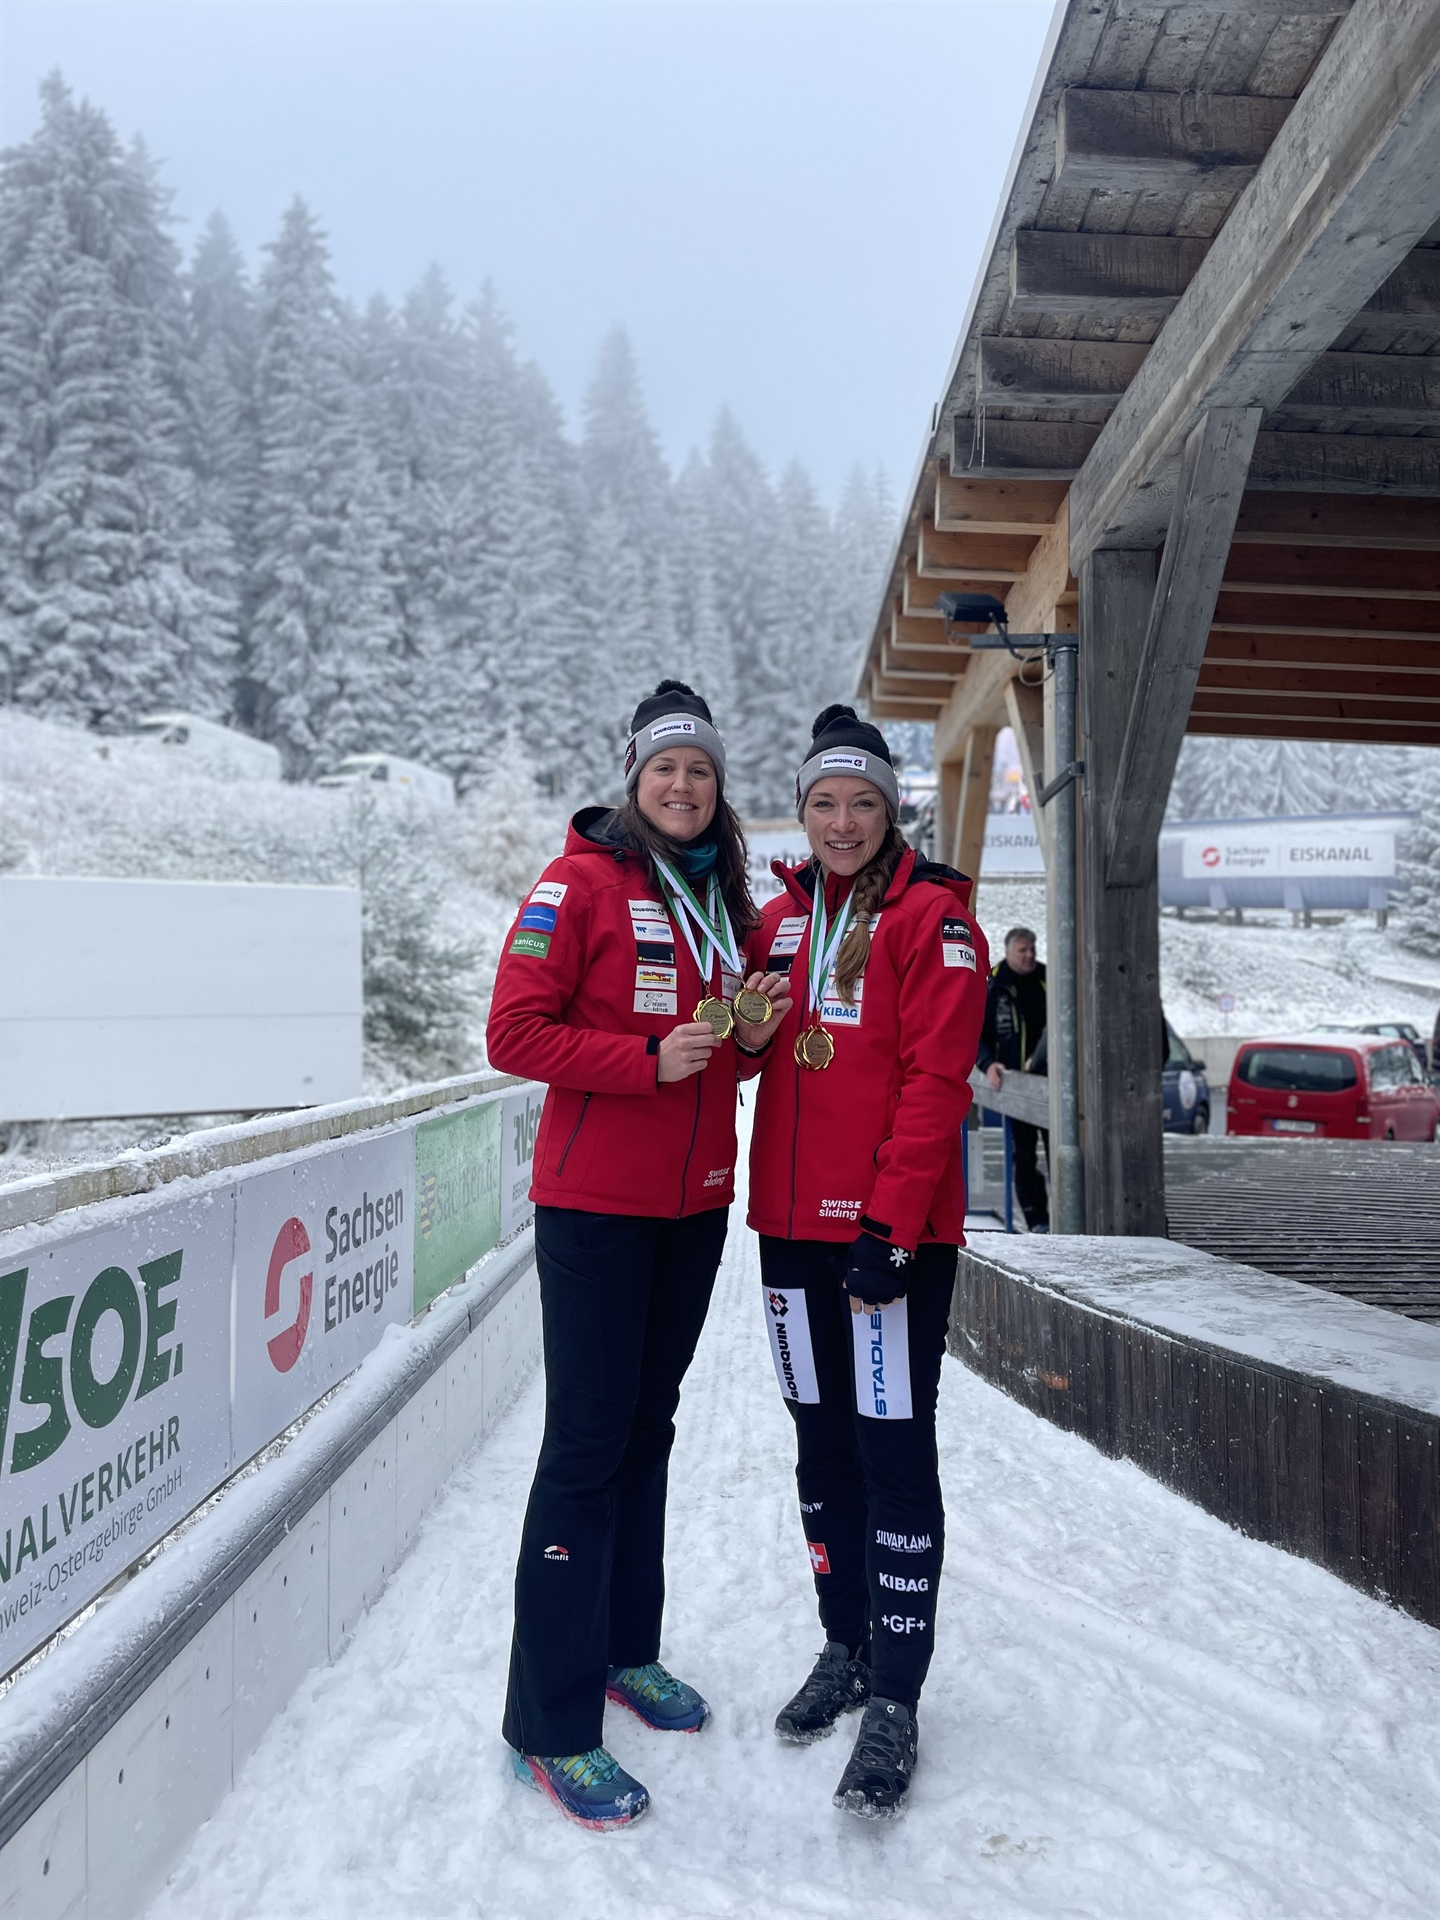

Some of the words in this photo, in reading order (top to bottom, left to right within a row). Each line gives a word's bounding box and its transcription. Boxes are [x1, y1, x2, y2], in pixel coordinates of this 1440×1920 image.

[653, 724, 682, 736] BOURQUIN
[823, 757, 852, 765] BOURQUIN
[1225, 846, 1270, 856] Sachsen
[1290, 847, 1373, 862] EISKANAL
[1225, 856, 1266, 868] Energie
[513, 937, 545, 949] sanicus
[823, 1005, 859, 1019] KIBAG
[703, 1176, 725, 1187] sliding
[821, 1199, 856, 1209] swiss
[818, 1207, 858, 1220] sliding
[325, 1188, 403, 1264] Sachsen
[324, 1243, 398, 1334] Energie
[775, 1322, 799, 1400] BOURQUIN
[870, 1306, 888, 1417] STADLE
[146, 1464, 182, 1513] GmbH
[875, 1529, 932, 1551] SILVAPLANA
[544, 1553, 570, 1561] skinfit
[879, 1571, 929, 1593] KIBAG
